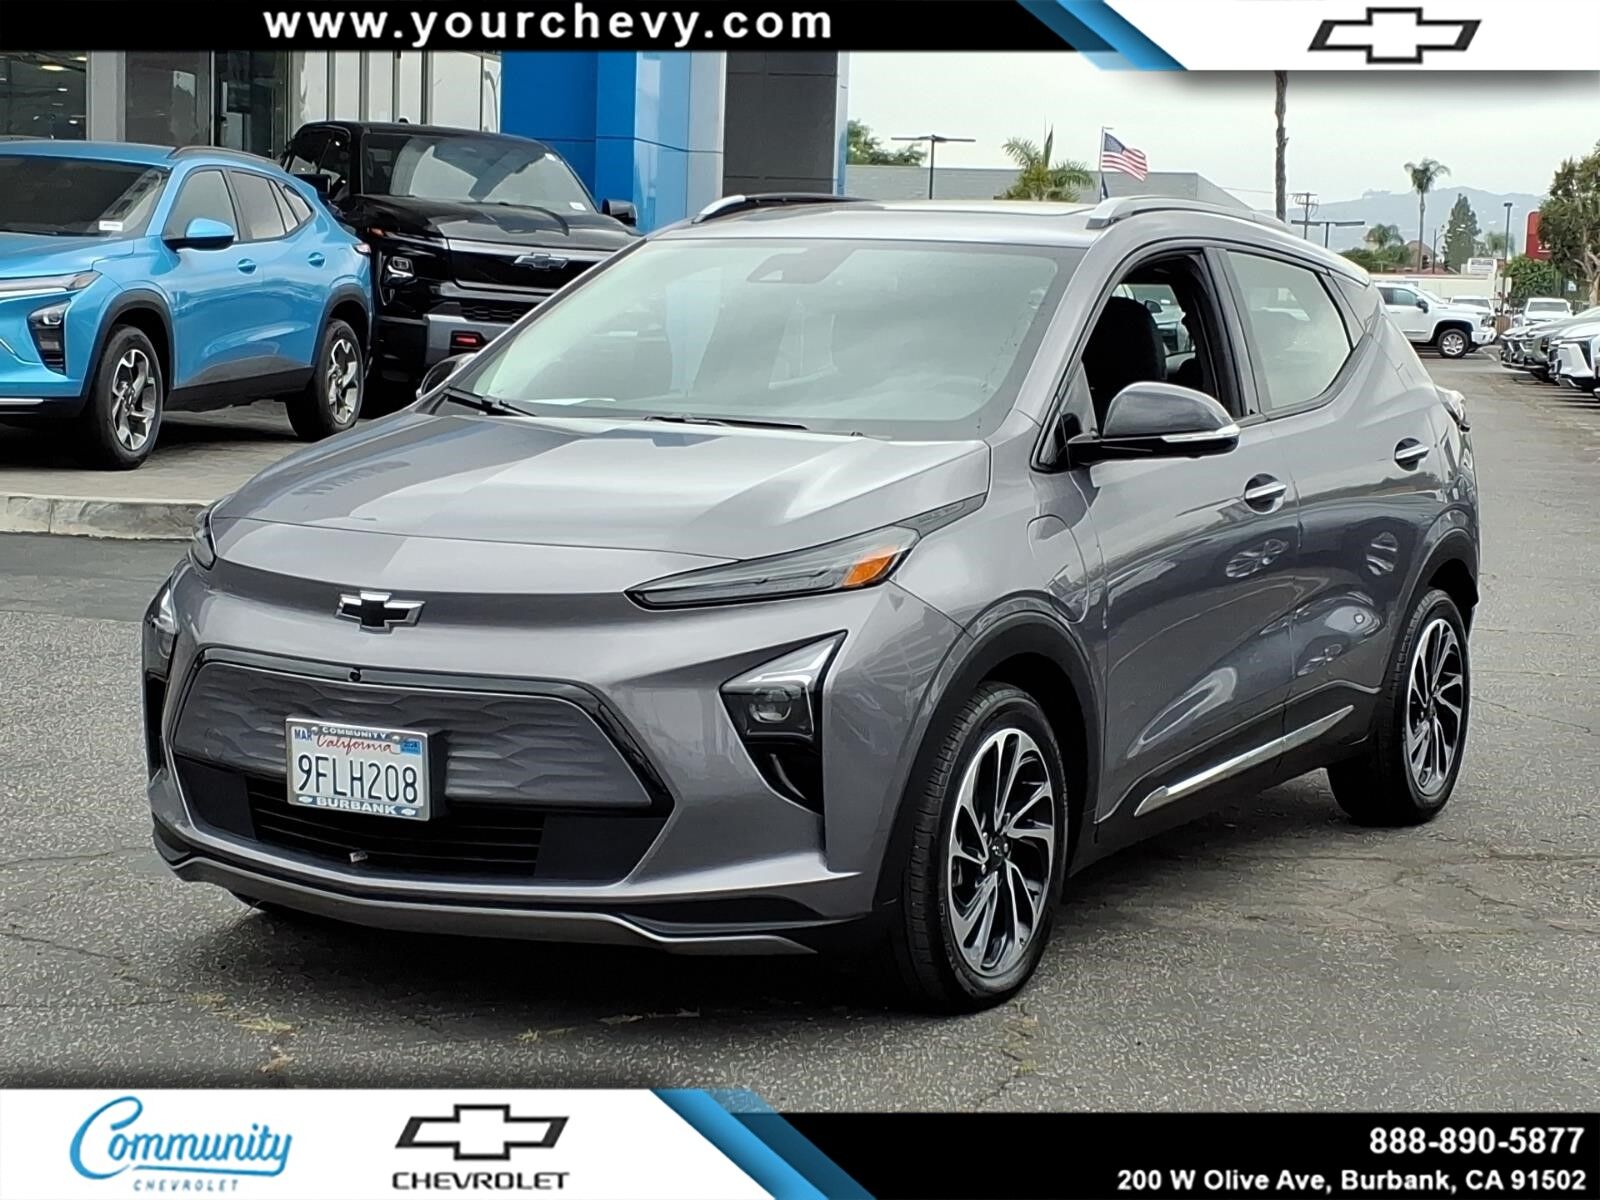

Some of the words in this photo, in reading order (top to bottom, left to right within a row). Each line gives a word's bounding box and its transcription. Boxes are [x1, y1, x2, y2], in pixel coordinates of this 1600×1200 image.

[294, 728, 313, 741] MAR
[322, 726, 387, 740] COMMUNITY
[316, 733, 394, 756] California
[298, 754, 418, 804] 9FLH208
[316, 796, 398, 815] BURBANK
